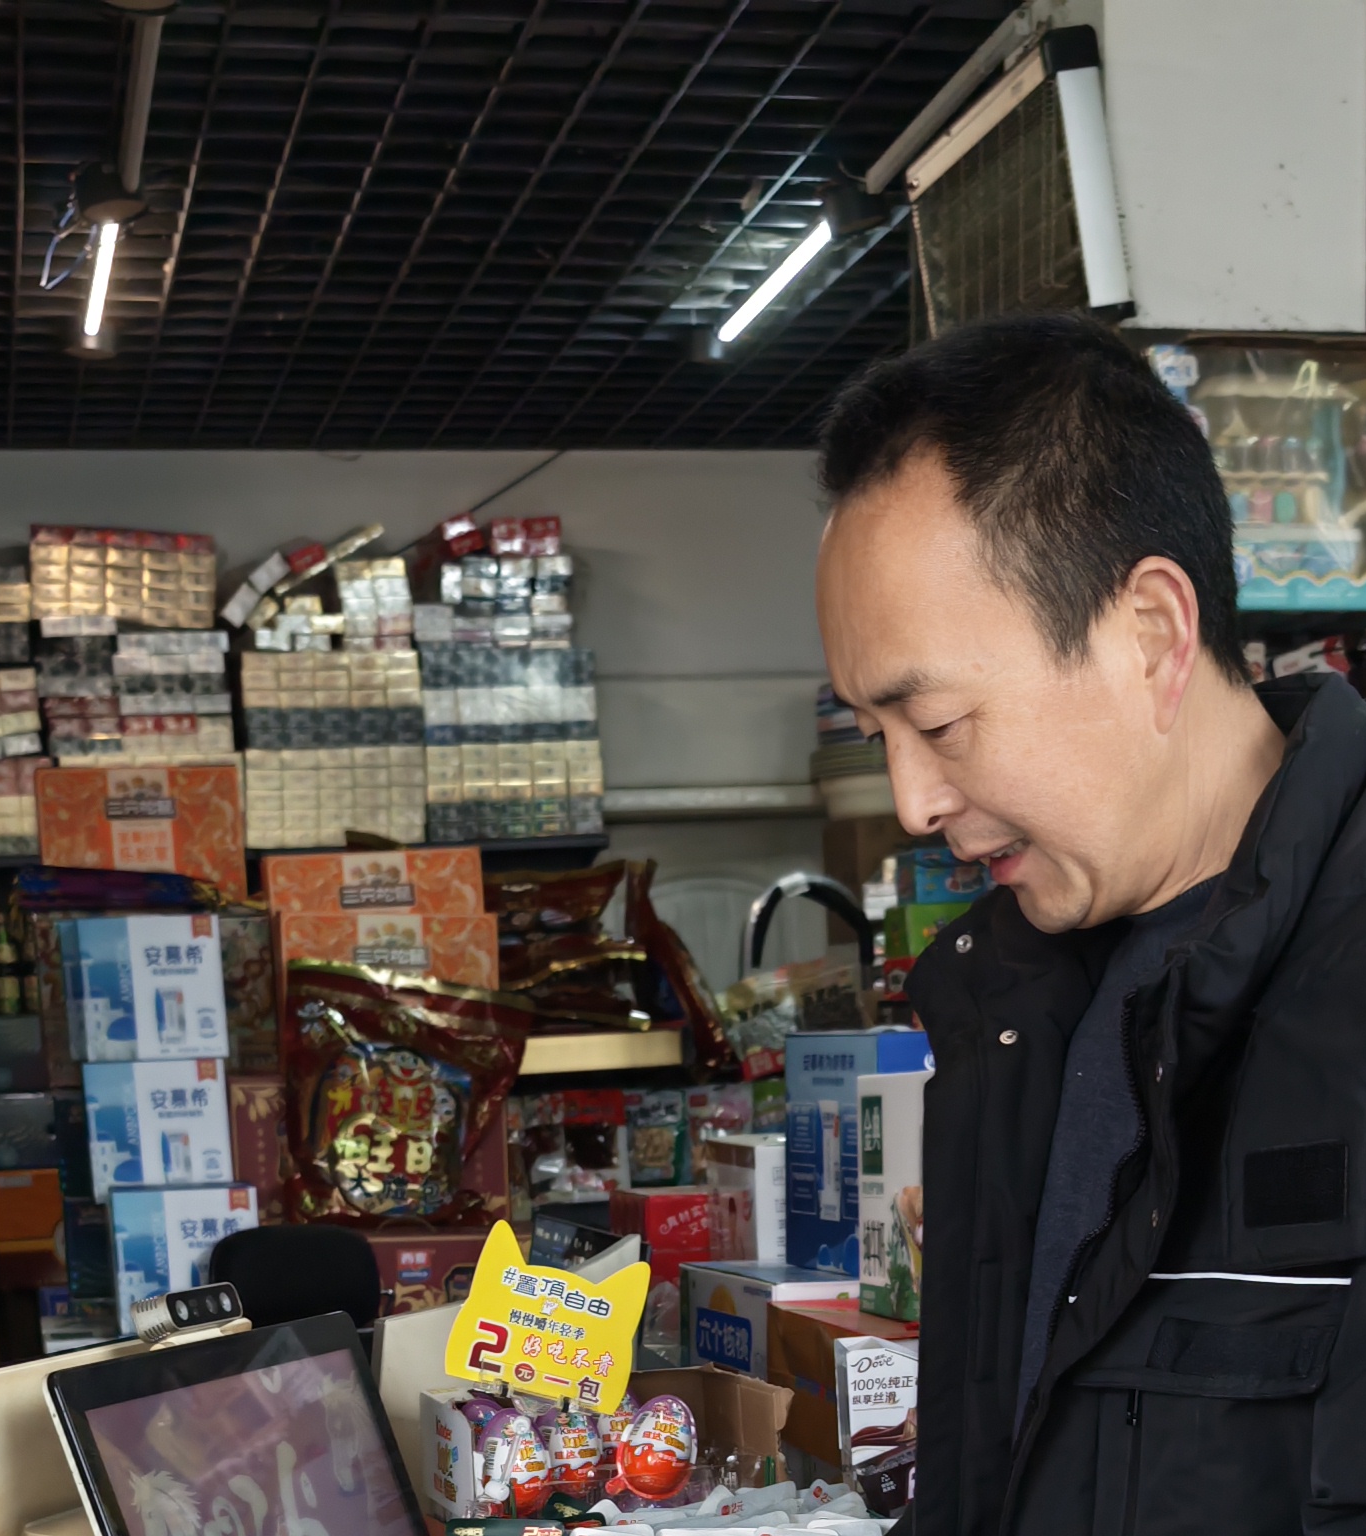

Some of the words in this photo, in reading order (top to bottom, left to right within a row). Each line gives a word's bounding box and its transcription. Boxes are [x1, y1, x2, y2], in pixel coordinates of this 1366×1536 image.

[144, 944, 204, 968] 安慕希
[150, 1088, 210, 1111] 安慕希
[509, 1309, 585, 1340] 慢慢嚼年轻季
[522, 1333, 614, 1377] 好吃不贵
[850, 1356, 894, 1373] Dove
[851, 1376, 918, 1391] 100%纯正
[852, 1391, 898, 1405] 纵享丝滑
